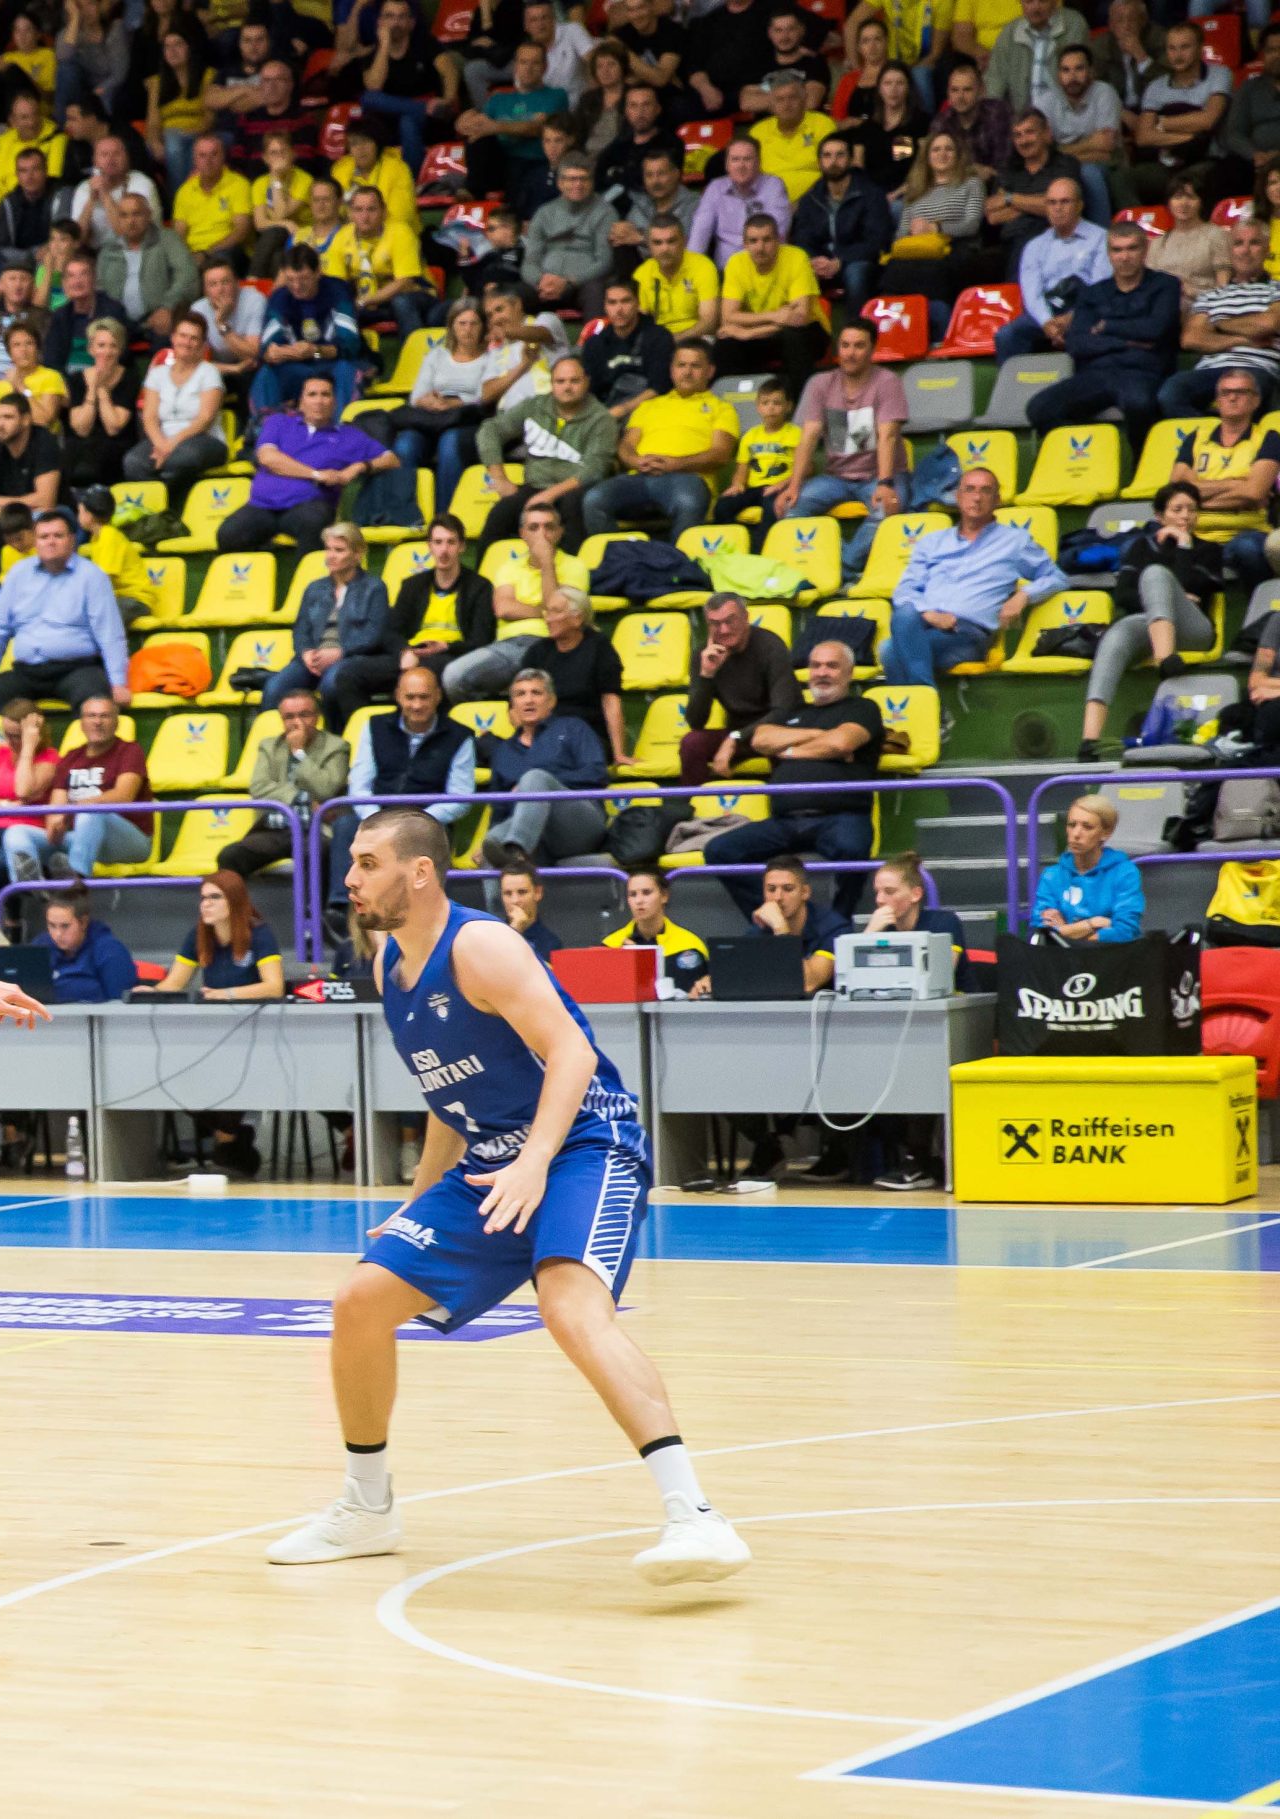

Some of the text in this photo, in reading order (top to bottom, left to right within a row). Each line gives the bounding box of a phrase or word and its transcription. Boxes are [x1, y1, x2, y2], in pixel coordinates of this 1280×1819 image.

[1017, 986, 1146, 1022] SPALDING
[1050, 1117, 1175, 1138] Raiffeisen
[1052, 1145, 1128, 1165] BANK
